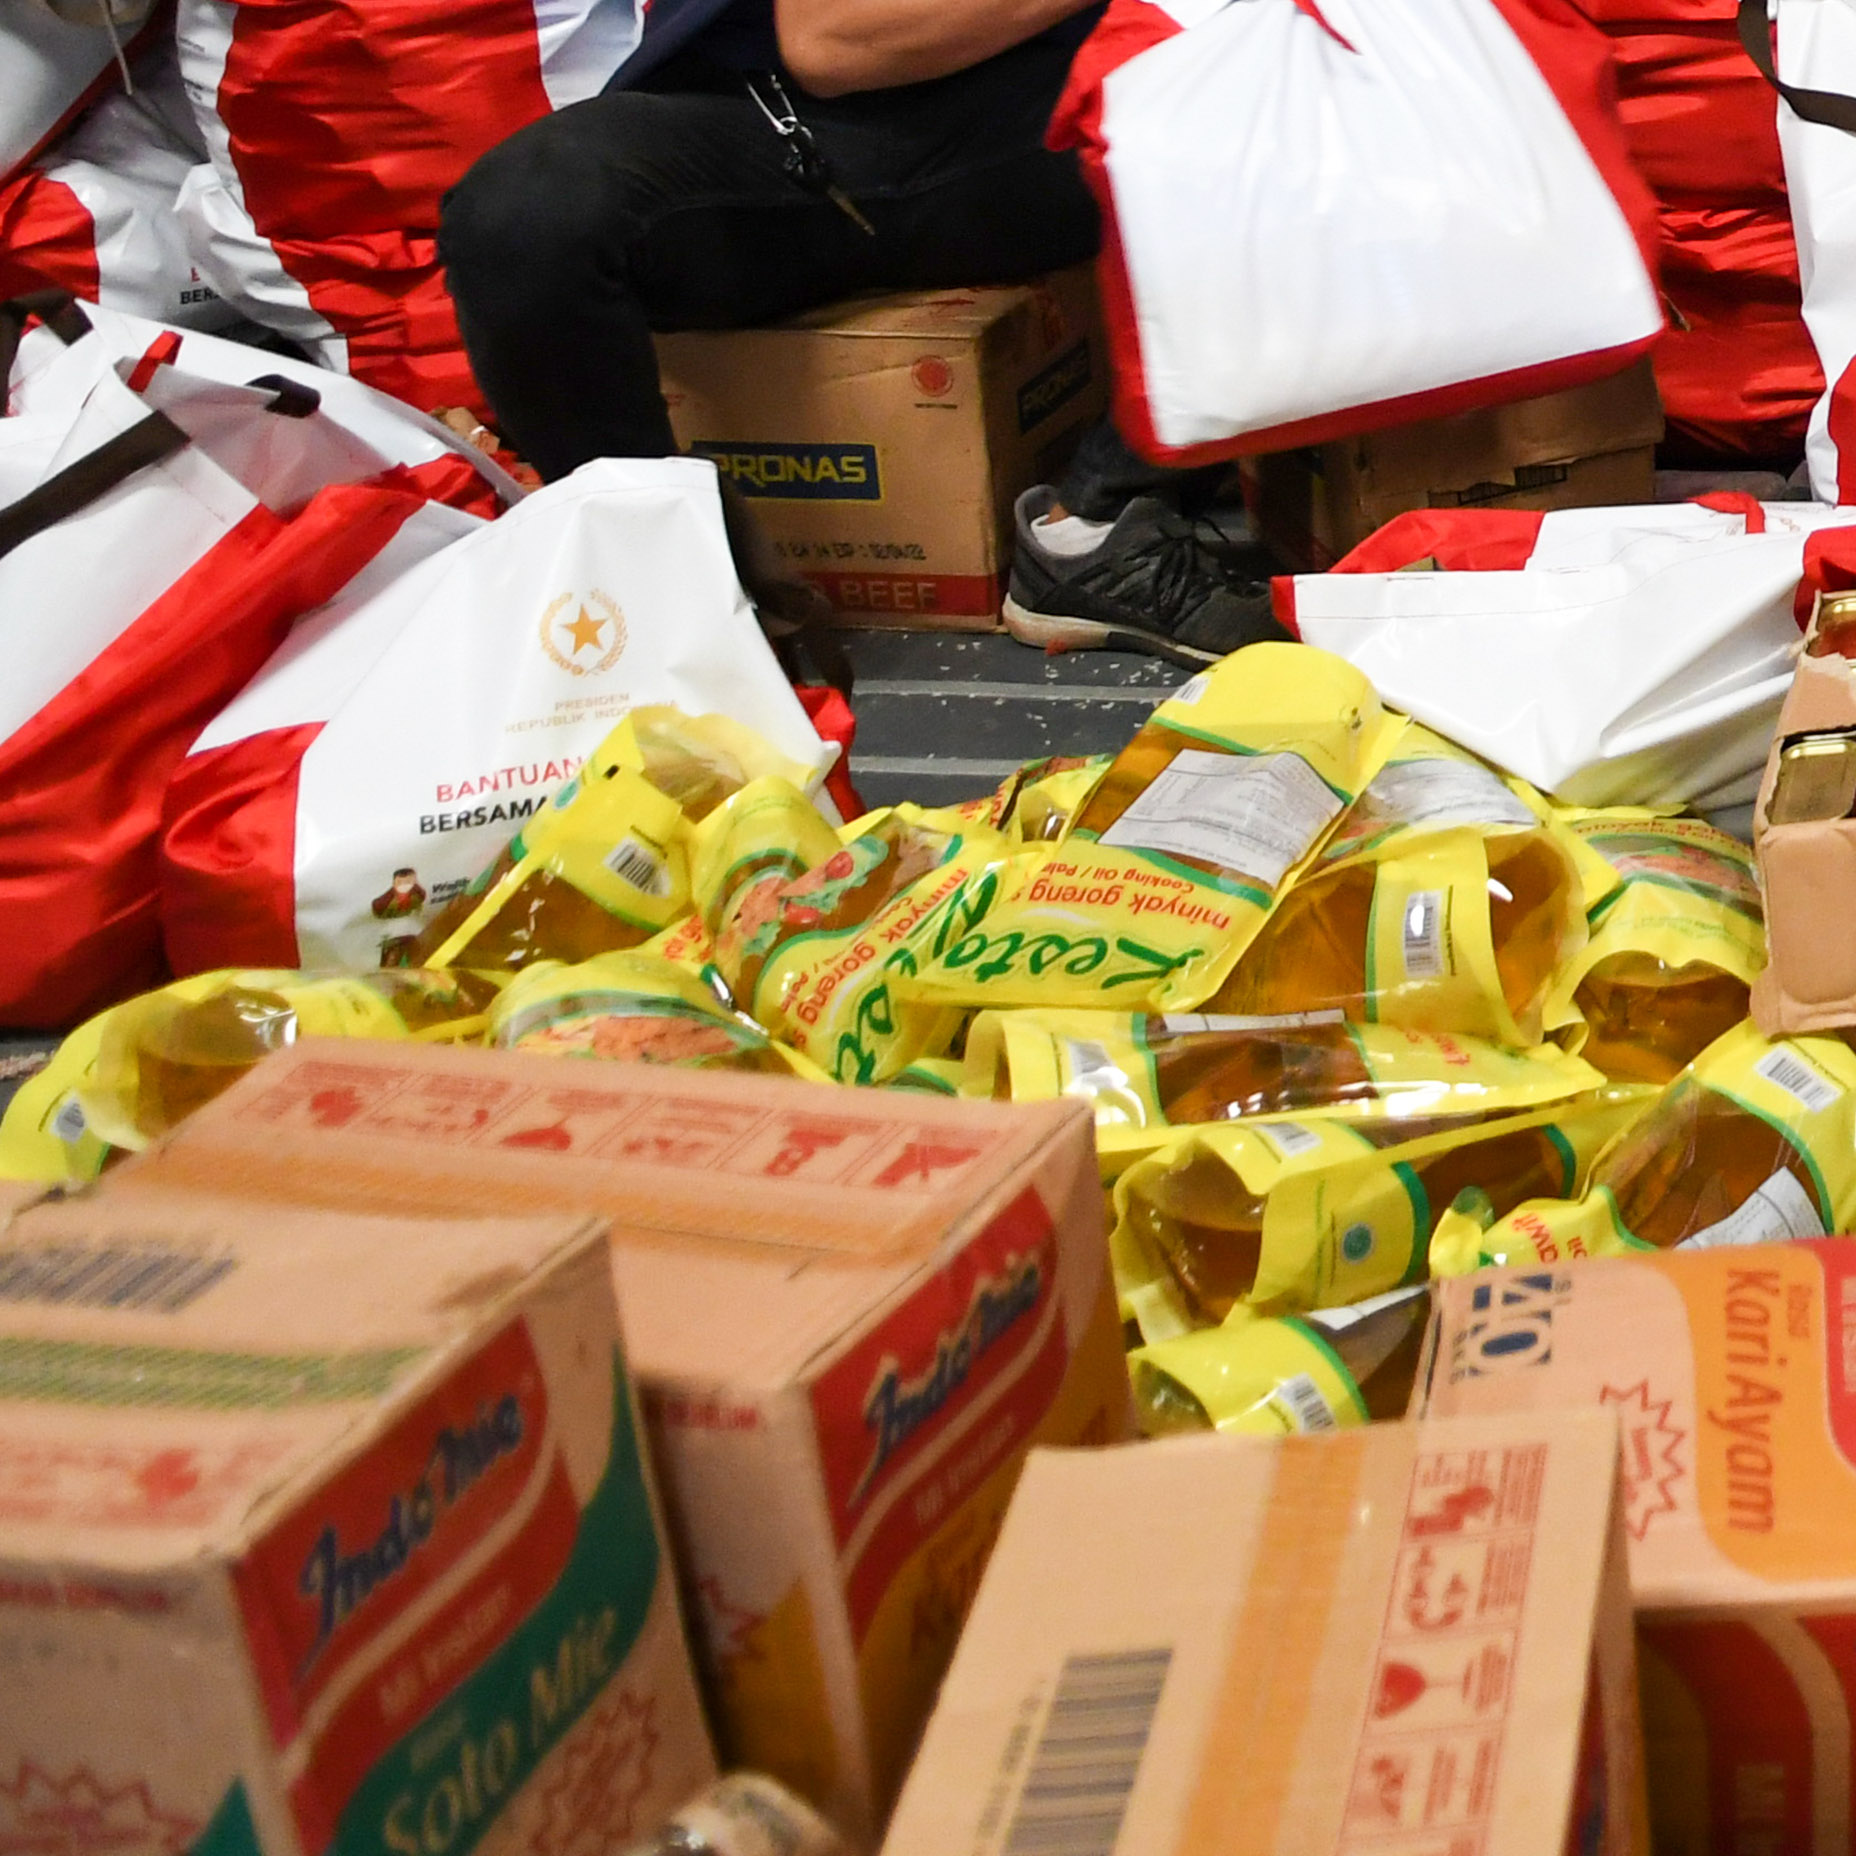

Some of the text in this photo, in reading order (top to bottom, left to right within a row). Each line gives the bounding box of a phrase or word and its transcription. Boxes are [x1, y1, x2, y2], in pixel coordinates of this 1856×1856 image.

[716, 453, 867, 488] PRONAS
[840, 579, 938, 610] BEEF
[505, 711, 586, 735] REPUBLIK
[554, 692, 630, 713] PRESIDEN
[435, 755, 584, 804] BANTUAN
[419, 796, 549, 837] BERSAMA
[1087, 865, 1118, 882] Oil
[1123, 864, 1195, 894] Cooking
[1029, 879, 1231, 932] minyak goreng
[795, 867, 969, 1028] minyak goreng
[1509, 1211, 1560, 1263] awit
[1470, 1272, 1553, 1378] 40
[1705, 1266, 1788, 1535] Kari Ayam
[385, 1604, 618, 1848] Soto Mie
